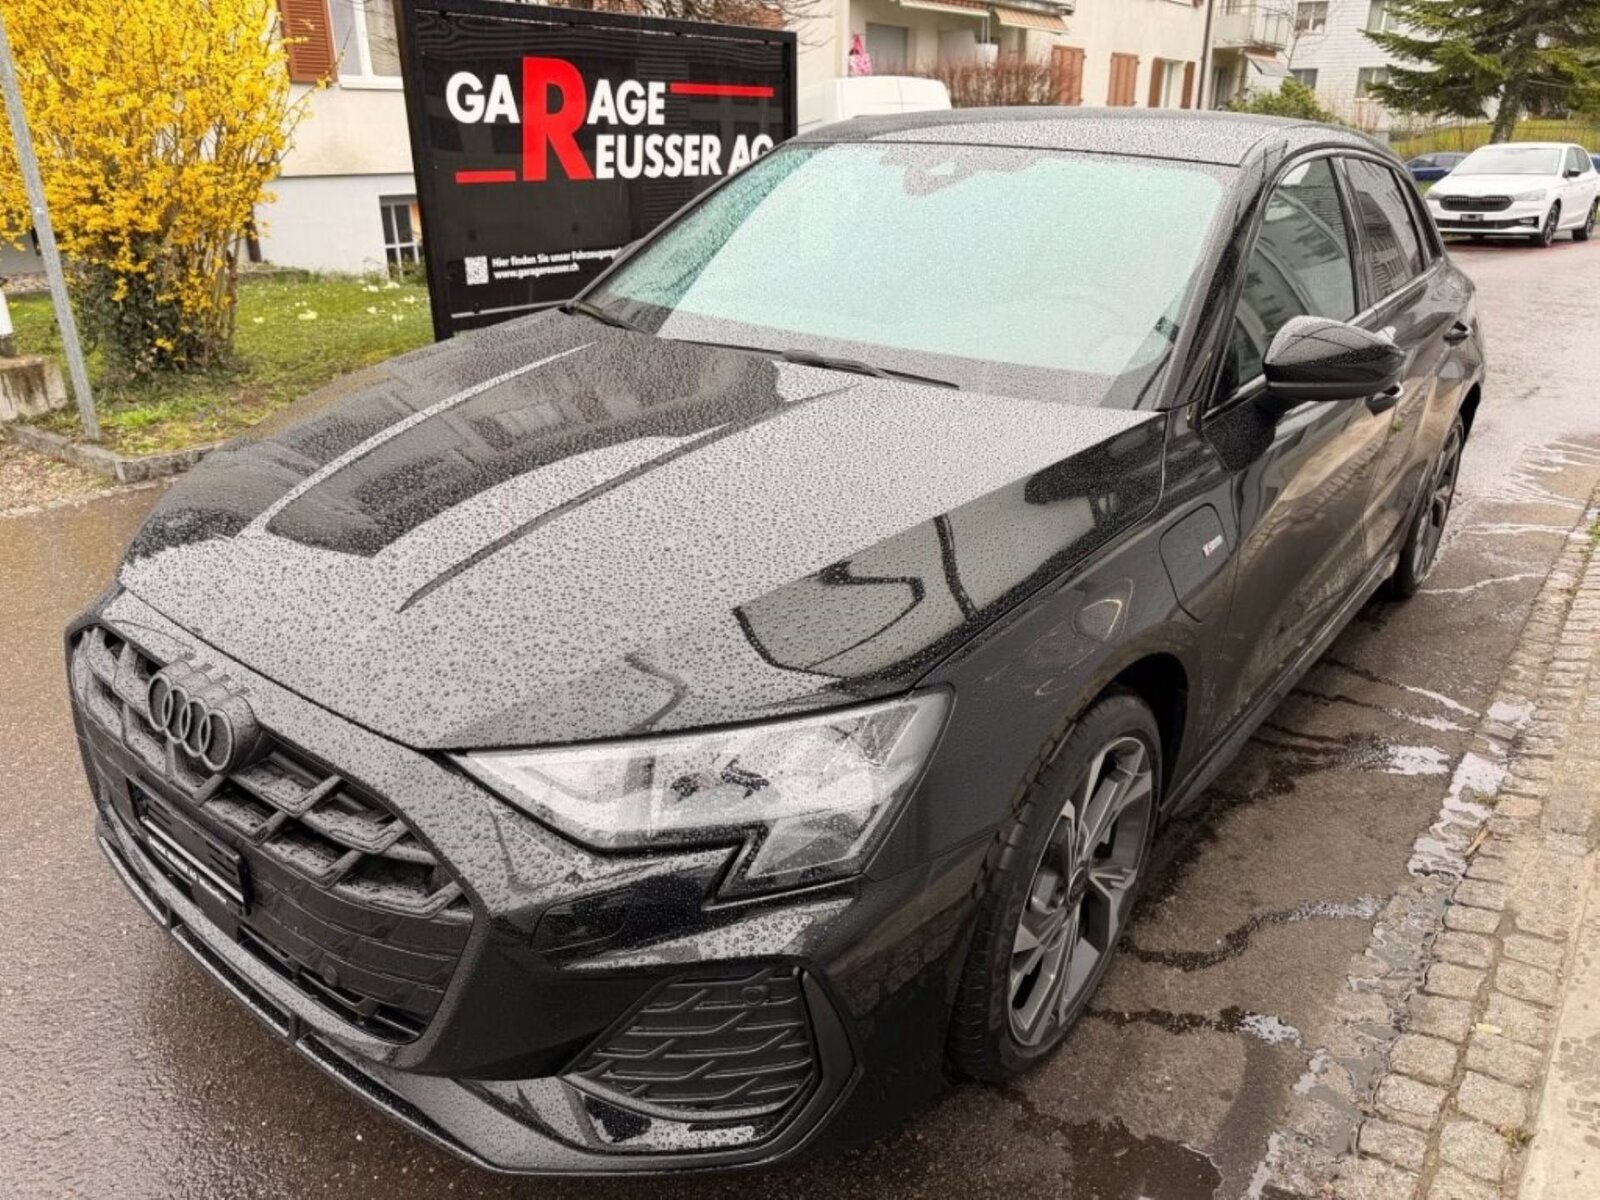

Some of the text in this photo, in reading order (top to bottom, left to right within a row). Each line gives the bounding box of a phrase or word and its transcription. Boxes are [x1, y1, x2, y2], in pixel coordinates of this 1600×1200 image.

[445, 56, 666, 182] GARAGE
[492, 257, 509, 267] Hier
[511, 255, 536, 265] finden
[537, 253, 549, 264] Sie
[550, 254, 571, 262] unser
